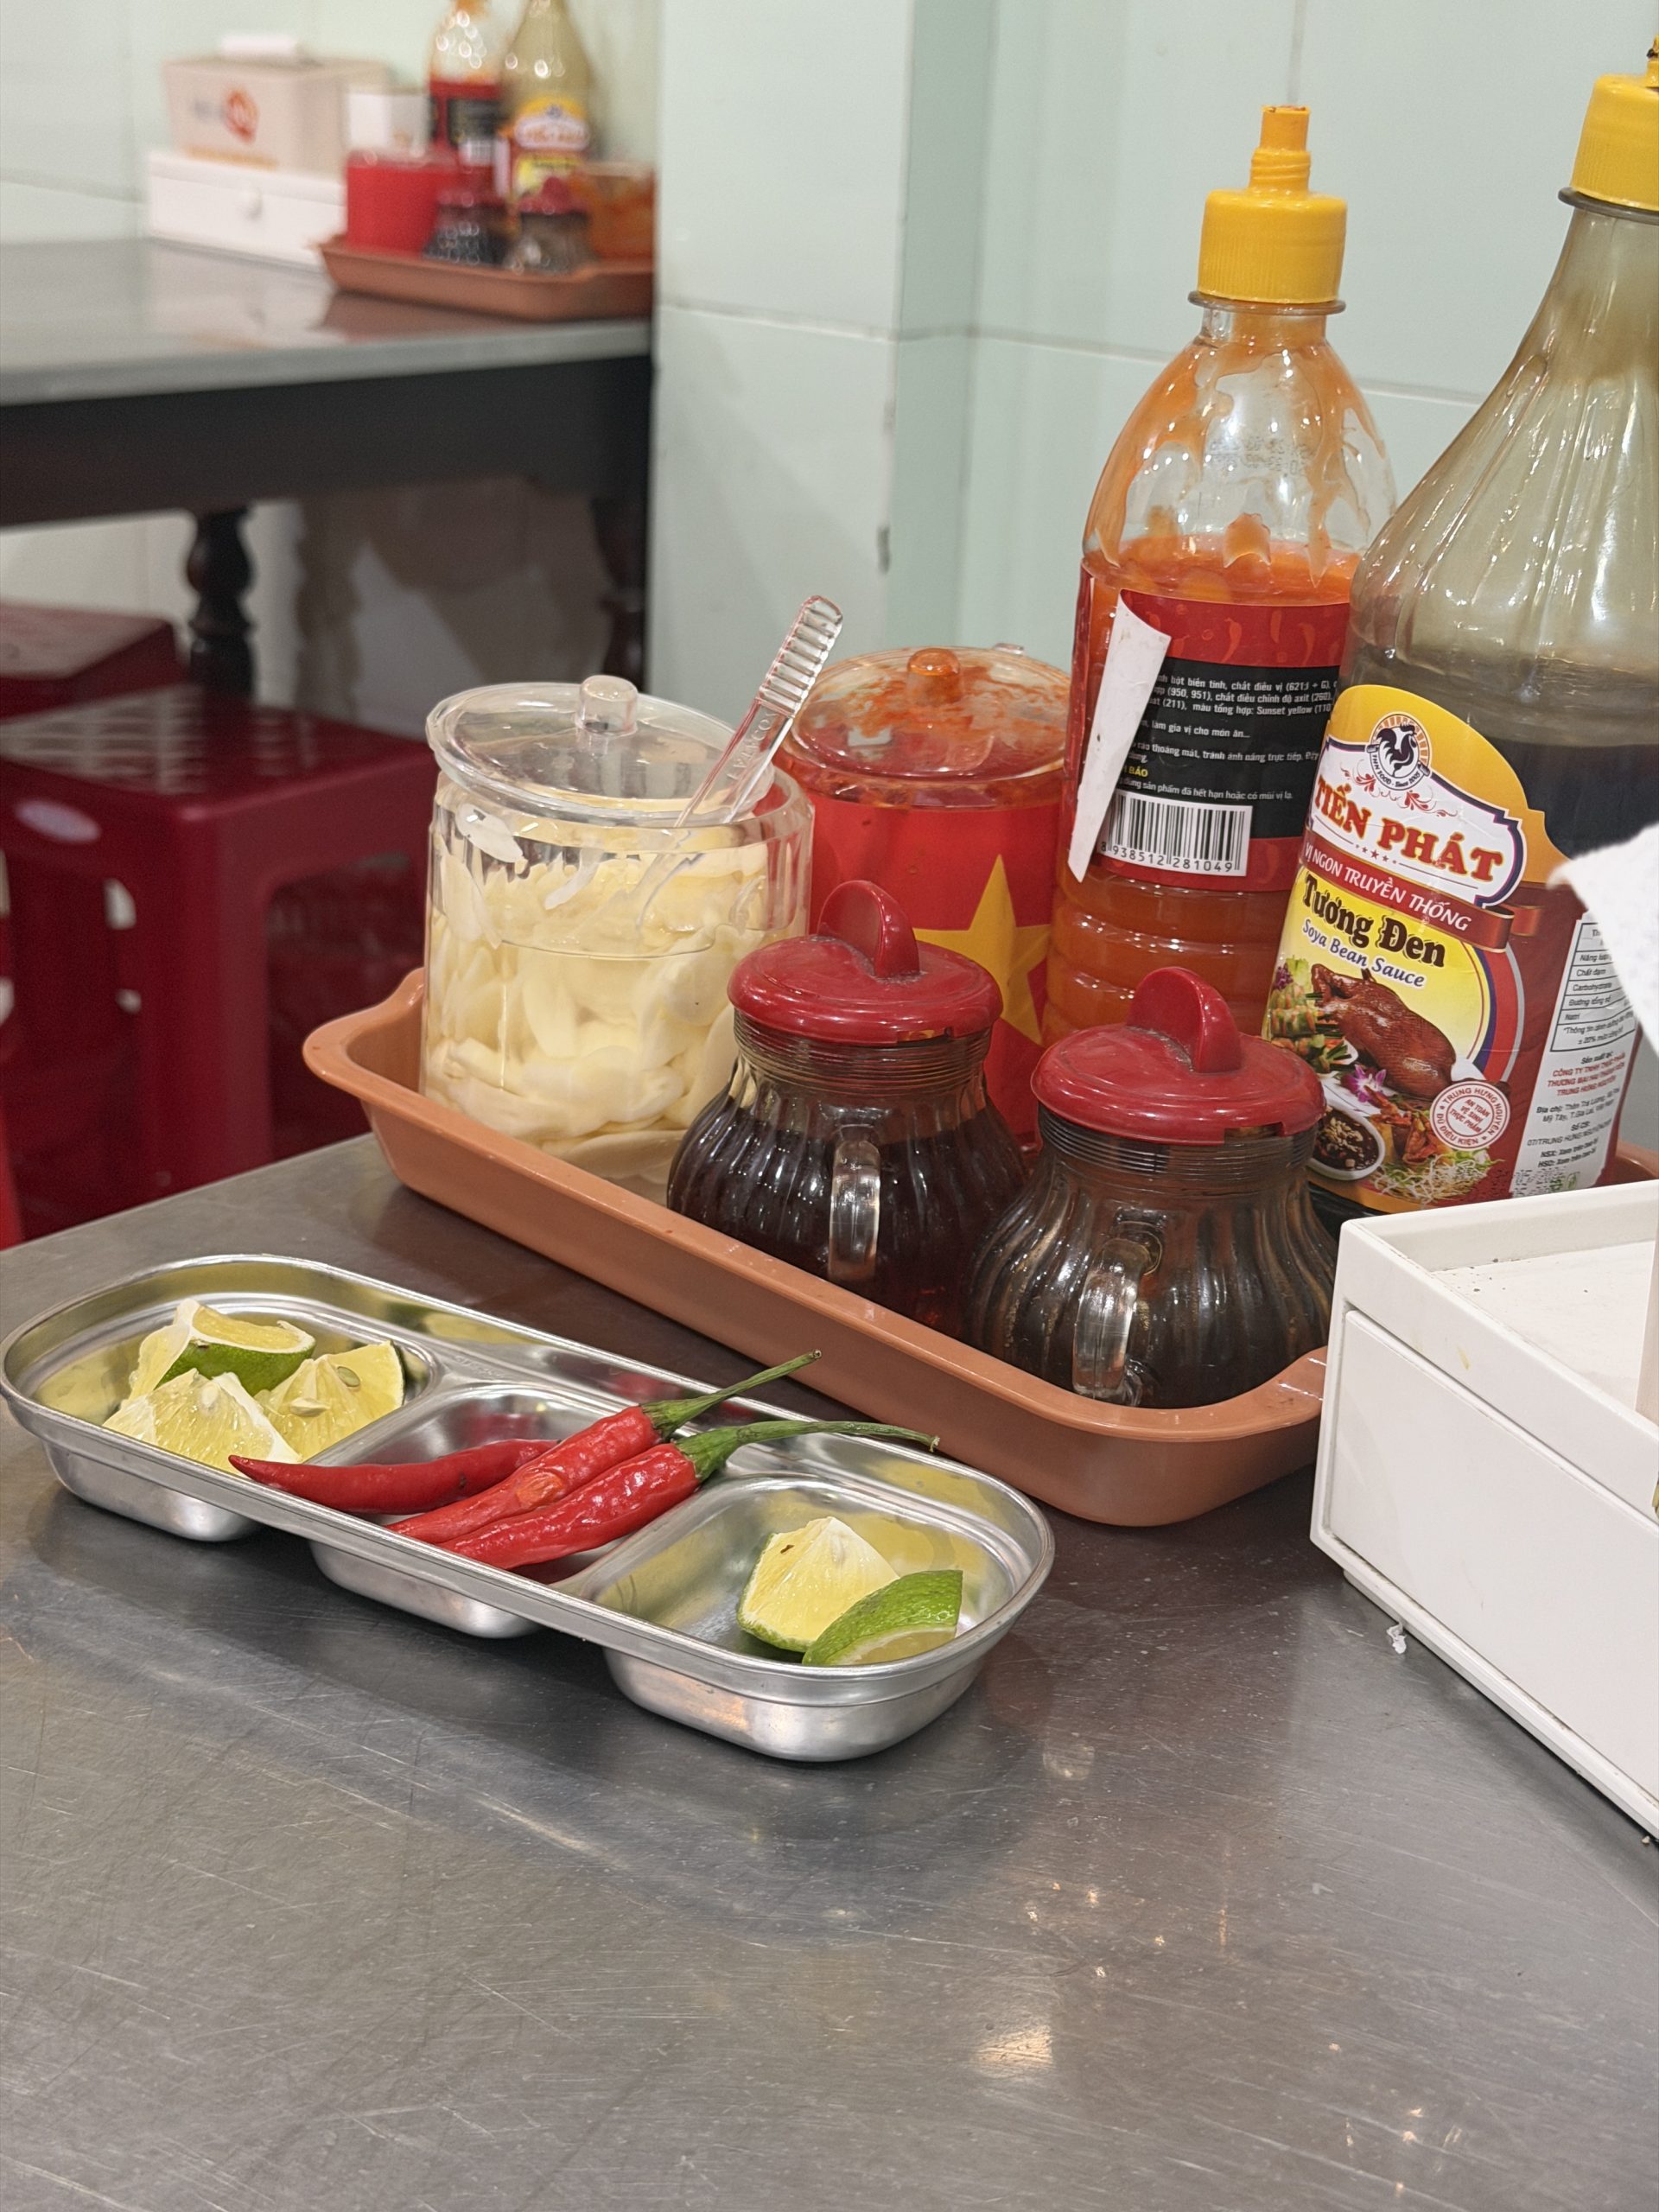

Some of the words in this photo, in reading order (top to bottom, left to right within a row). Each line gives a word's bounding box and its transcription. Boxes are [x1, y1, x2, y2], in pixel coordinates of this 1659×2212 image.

[1256, 707, 1286, 715] Sunset
[1287, 706, 1313, 716] yellow
[1193, 727, 1209, 735] cho
[1314, 775, 1372, 840] TIỀN
[1376, 817, 1504, 882] PHÁT
[1173, 857, 1232, 873] 281049
[1314, 853, 1344, 878] NGON
[1344, 867, 1407, 904] TRUYỀN
[1408, 893, 1471, 931] THỐNG
[1303, 918, 1327, 948] Soya
[1330, 938, 1367, 967] Bean
[1371, 957, 1425, 988] Sauce
[1376, 914, 1446, 968] Đen
[1442, 1087, 1471, 1104] TRUNG
